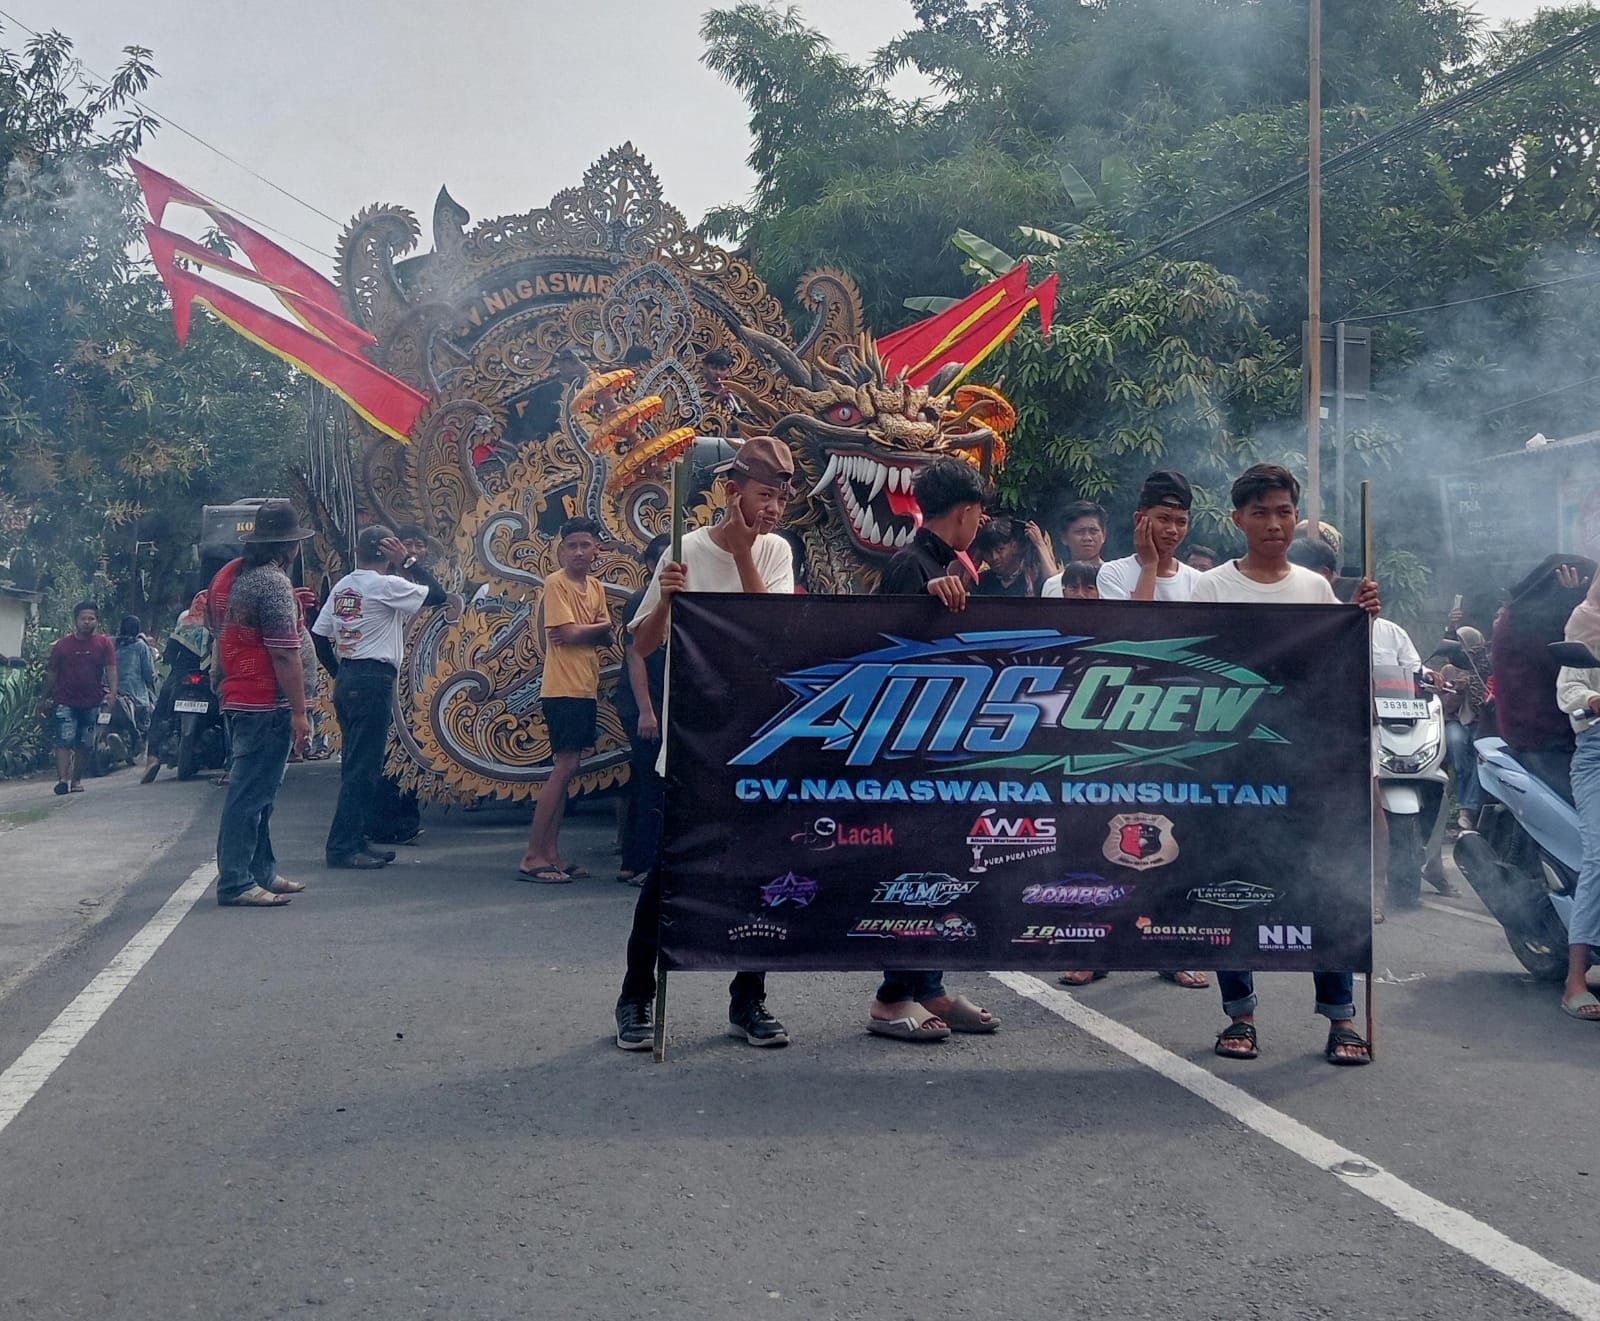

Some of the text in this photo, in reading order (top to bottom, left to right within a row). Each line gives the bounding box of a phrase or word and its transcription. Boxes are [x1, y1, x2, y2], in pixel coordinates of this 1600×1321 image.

[735, 778, 1288, 806] CV.NAGASWARA KONSULTAN
[837, 822, 895, 845] Lacak
[969, 816, 1057, 837] AWAS
[1197, 889, 1242, 899] Lancar
[1245, 891, 1276, 900] Jaya
[855, 919, 936, 931] BENGKEL
[1258, 925, 1312, 945] NN
